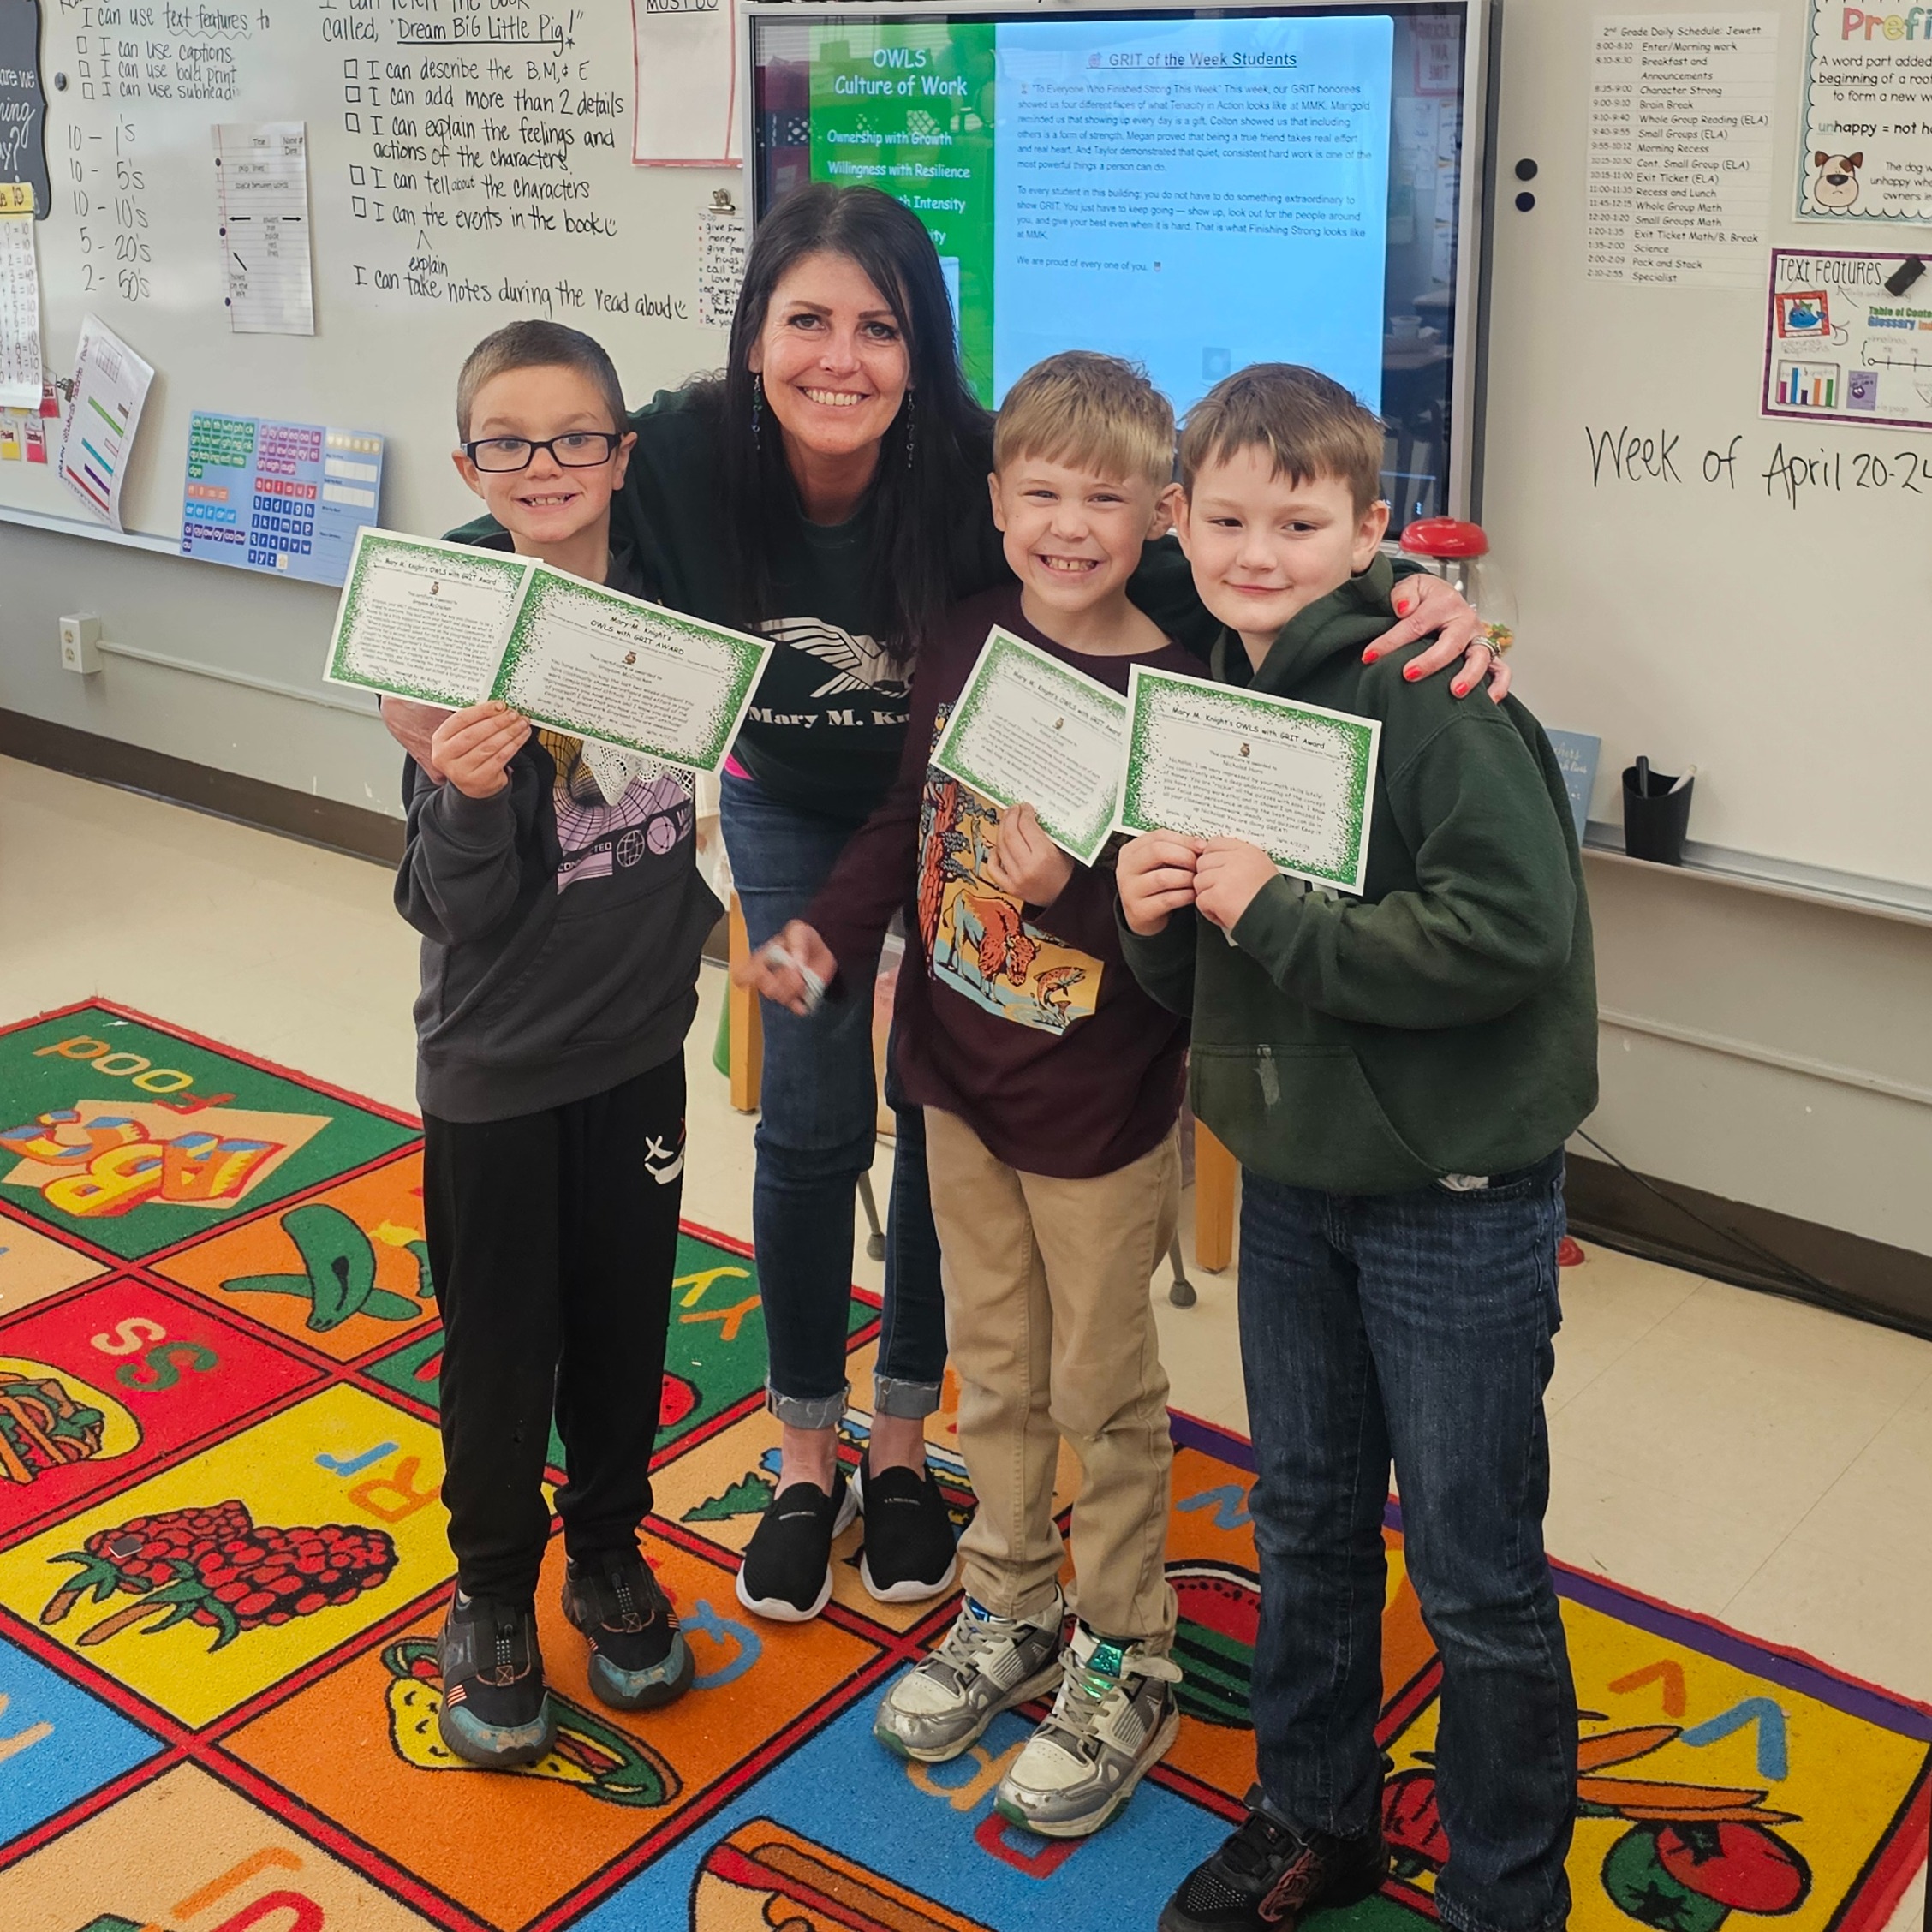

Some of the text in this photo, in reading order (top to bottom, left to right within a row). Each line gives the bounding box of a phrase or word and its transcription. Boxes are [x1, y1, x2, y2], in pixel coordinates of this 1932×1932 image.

[81, 7, 93, 28] I
[98, 9, 121, 26] can
[130, 7, 154, 27] use
[163, 2, 192, 29] text
[196, 4, 248, 31] features
[257, 9, 270, 31] to
[323, 16, 378, 42] called,
[488, 15, 529, 40] Little
[1621, 27, 1649, 37] Grade
[1651, 27, 1673, 39] Daily
[1726, 26, 1762, 36] Jewett
[98, 37, 232, 71] I can use captions
[873, 48, 927, 68] OWLS
[1109, 51, 1297, 66] GRIT of the Week Students
[1642, 43, 1738, 54] Enter/Morning work
[367, 61, 380, 80] I
[386, 63, 411, 80] can
[420, 57, 479, 80] describe
[486, 58, 513, 80] the
[1642, 57, 1708, 66] Breakfast and
[1819, 55, 1932, 72] A word part added
[835, 75, 968, 96] Culture of Work
[1641, 72, 1713, 80] Announcements
[1818, 72, 1877, 86] beginning
[1881, 73, 1894, 84] of
[1047, 85, 1083, 96] Everyone
[1087, 85, 1105, 93] Who
[1107, 85, 1142, 94] Finished
[1144, 85, 1171, 96] Strong
[1174, 85, 1191, 93] This
[1225, 85, 1243, 93] This
[1291, 84, 1315, 93] GRIT
[1317, 84, 1361, 93] honorees
[1640, 86, 1722, 98] Character Strong
[1834, 91, 1917, 102] to form a new
[369, 85, 624, 117] I can add more than 2 details
[1640, 115, 1768, 127] Whole Group Reading (ELA)
[1818, 121, 1917, 137] unhappy not
[69, 124, 82, 151] 10
[370, 115, 615, 160] I can explain the feelings and
[827, 129, 952, 146] Ownership with Growth
[373, 140, 426, 161] actions
[432, 144, 450, 167] of
[457, 145, 484, 168] the
[70, 158, 83, 182] 10
[827, 160, 971, 179] Willingness with Resilience
[1887, 162, 1923, 174] The dog
[371, 167, 386, 188] I
[394, 173, 417, 190] can
[424, 171, 450, 195] tell
[480, 174, 507, 199] the
[514, 176, 589, 201] characters
[1636, 188, 1667, 197] Recess
[1690, 189, 1716, 198] Lunch
[1870, 176, 1910, 191] unhappy
[73, 190, 89, 217] 10
[913, 195, 966, 214] Intensity
[373, 201, 604, 235] I can the events in the book
[80, 227, 92, 253] 5
[82, 264, 96, 291] 2
[409, 254, 449, 280] explain
[353, 265, 672, 319] I can take notes during the read aloud
[1585, 426, 1683, 487] Week
[1703, 435, 1742, 489] of
[1762, 442, 1840, 510] April
[748, 707, 818, 729] Mary
[826, 709, 864, 726] M.
[1172, 707, 1190, 718] Mary
[1236, 721, 1259, 733] OWLS
[1261, 729, 1277, 738] with
[1280, 732, 1299, 742] GRIT
[1303, 738, 1325, 749] Award
